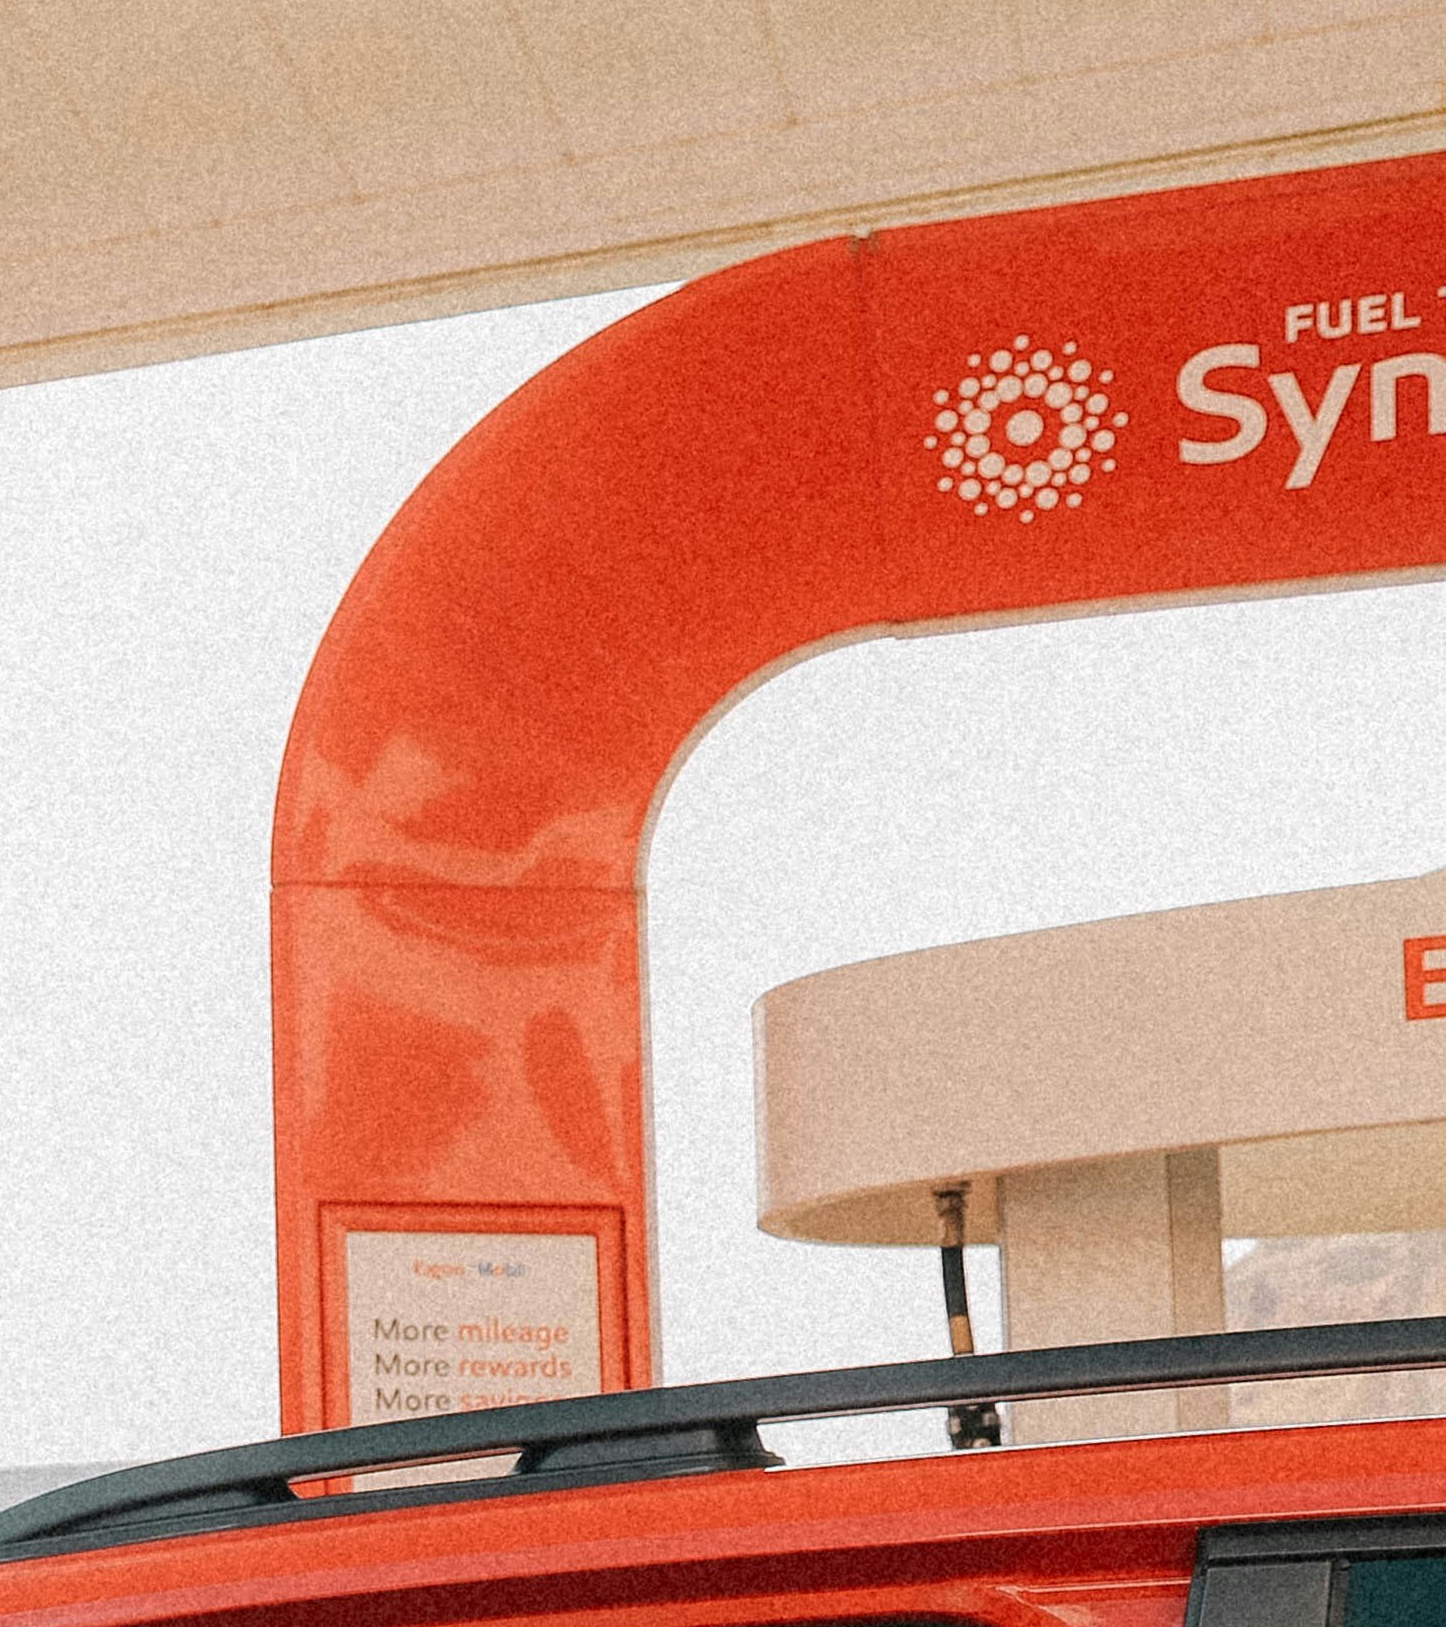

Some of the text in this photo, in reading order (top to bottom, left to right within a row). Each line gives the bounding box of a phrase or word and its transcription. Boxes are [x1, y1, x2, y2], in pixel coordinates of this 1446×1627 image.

[1284, 291, 1421, 344] FUEL
[373, 1316, 569, 1351] More mileage
[375, 1353, 573, 1379] More rewards
[376, 1388, 451, 1412] More
